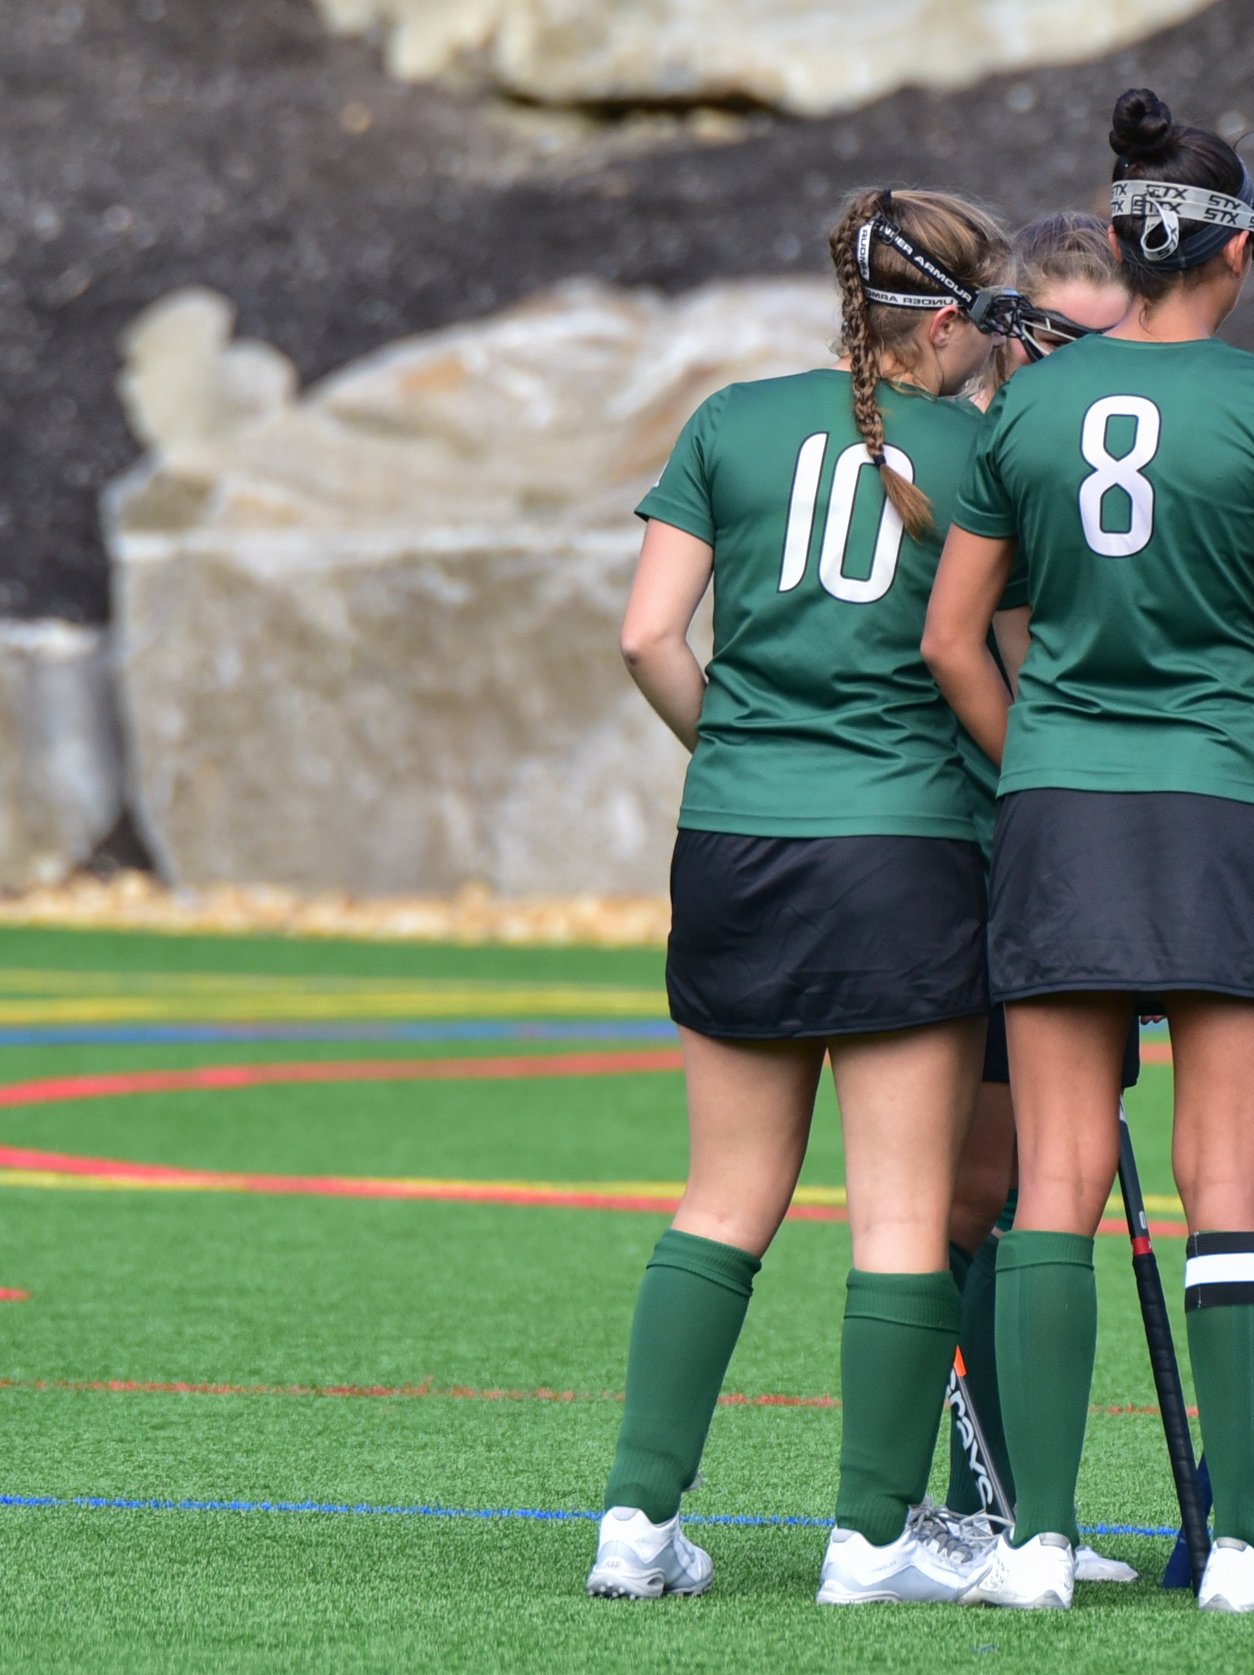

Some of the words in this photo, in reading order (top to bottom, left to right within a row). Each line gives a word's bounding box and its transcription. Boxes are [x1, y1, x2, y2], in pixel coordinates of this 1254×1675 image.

[1203, 207, 1238, 226] STX
[914, 255, 973, 303] ARMOUR
[777, 431, 915, 603] 10
[1078, 394, 1161, 558] 8
